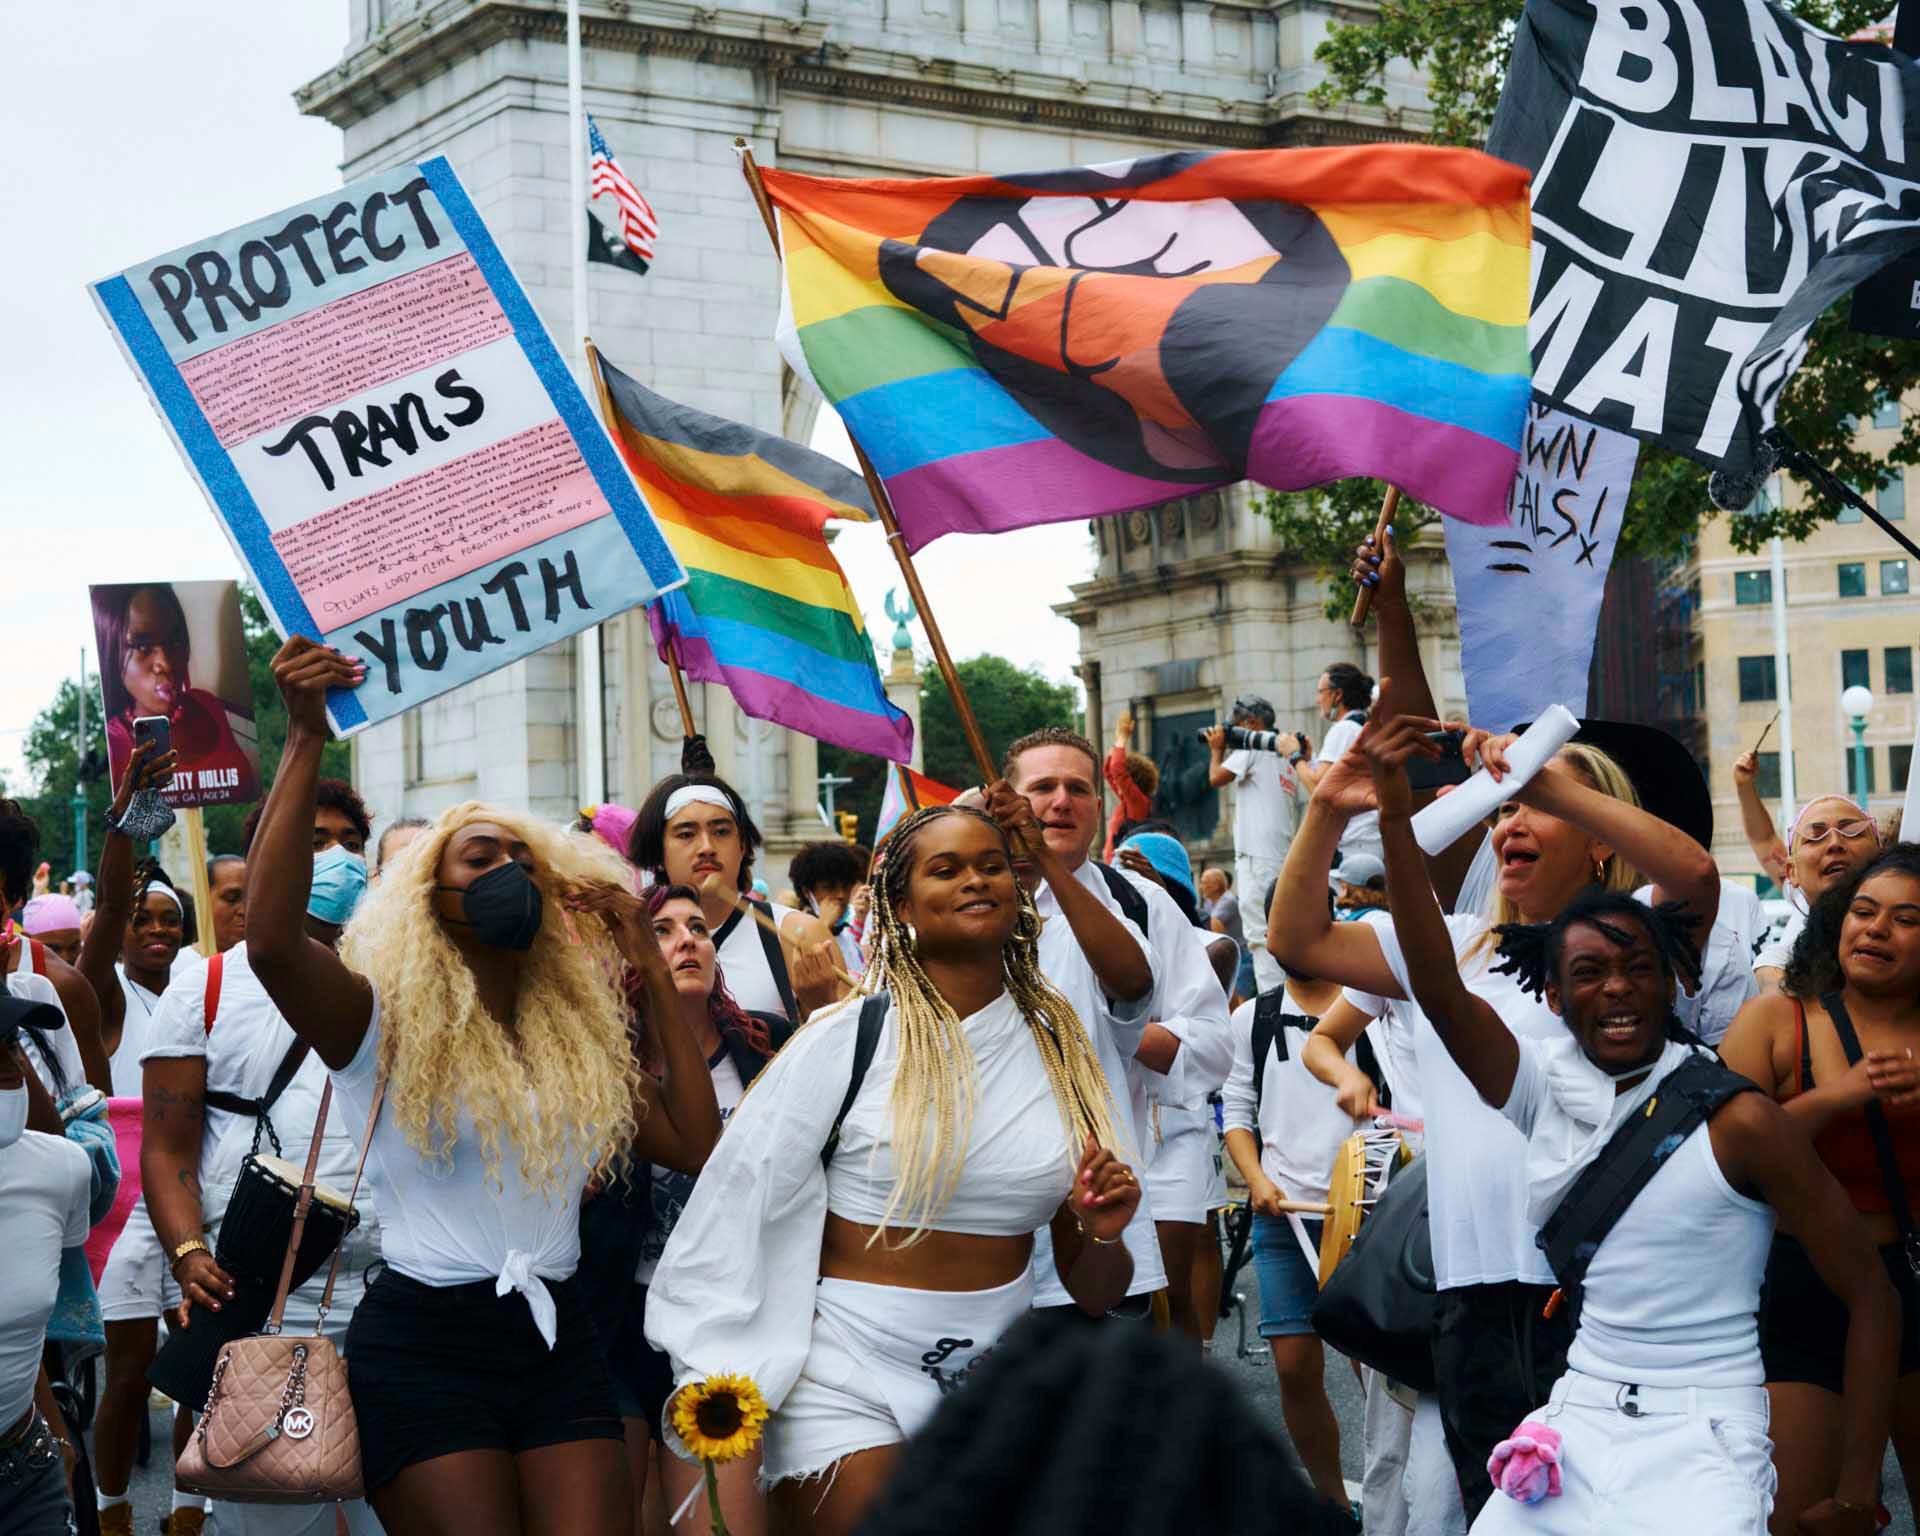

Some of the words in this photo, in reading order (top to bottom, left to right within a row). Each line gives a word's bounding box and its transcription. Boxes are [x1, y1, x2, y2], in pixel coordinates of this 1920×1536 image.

[150, 177, 439, 344] PROTECT
[1529, 240, 1775, 458] MAT
[1526, 421, 1597, 481] WN
[354, 551, 593, 695] YOUTH
[198, 768, 239, 789] HOLLIS
